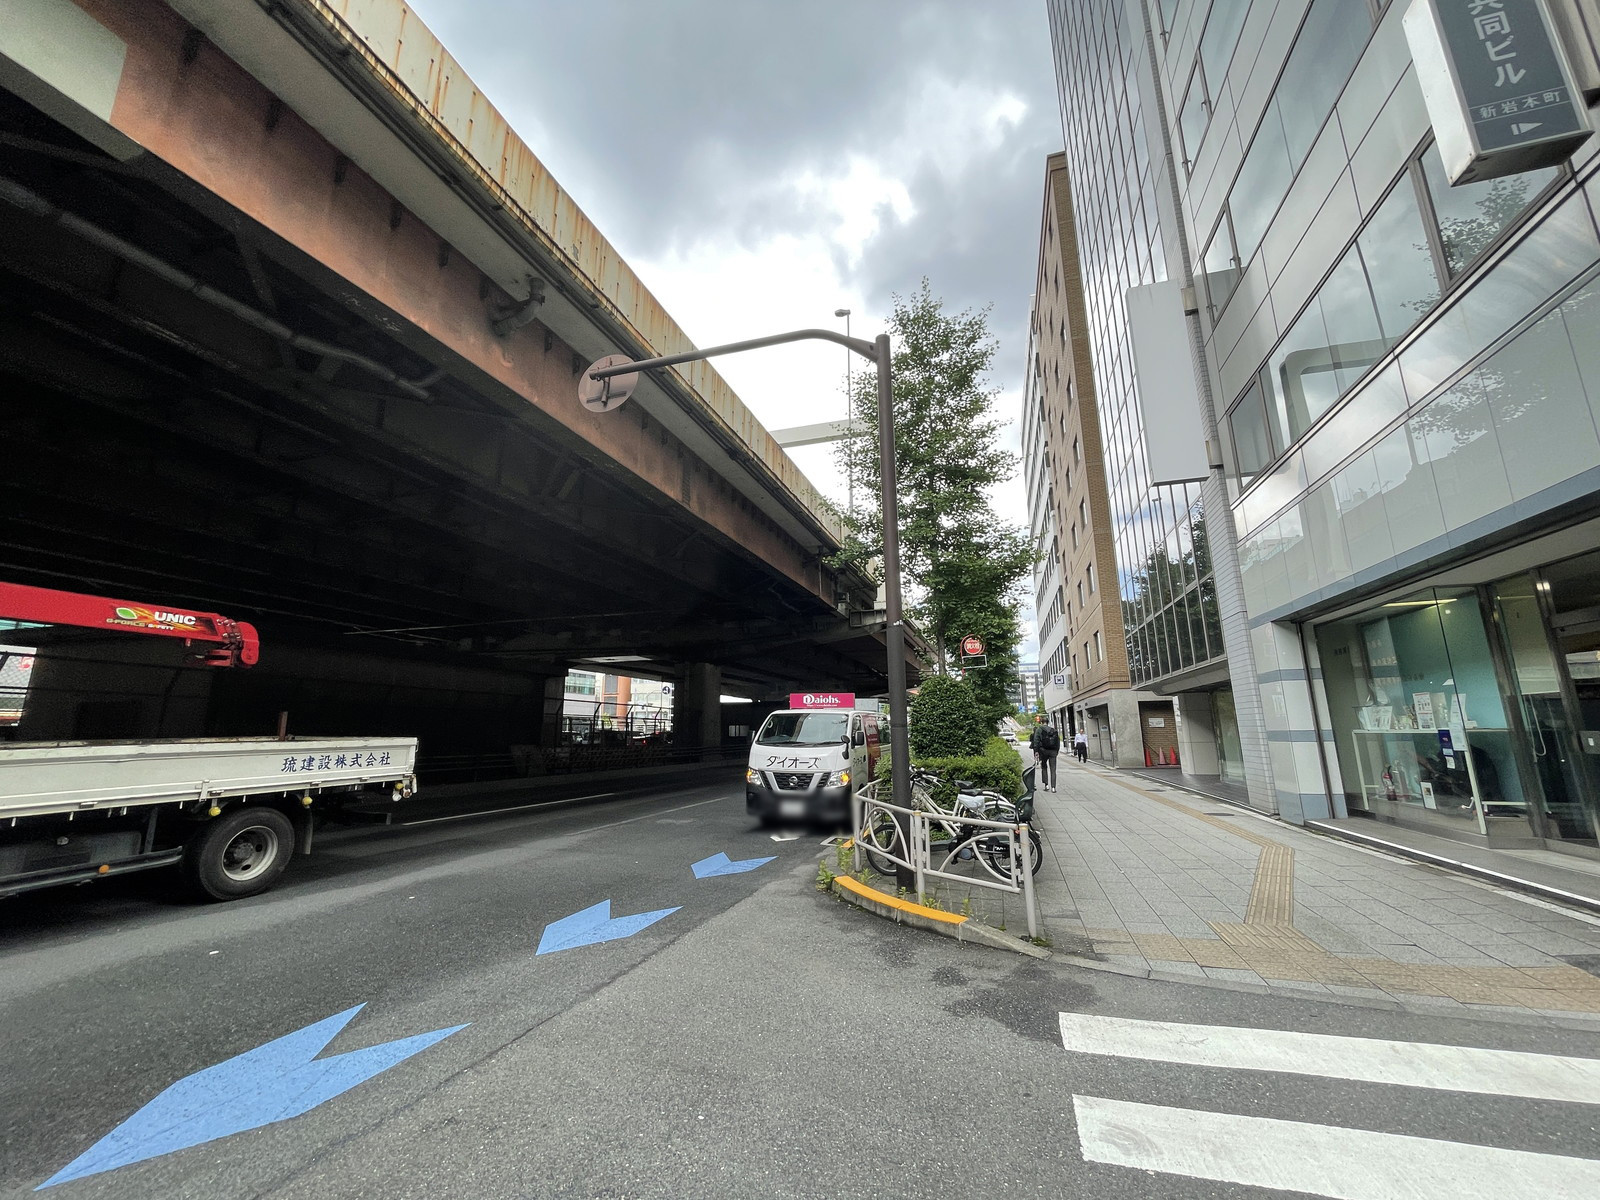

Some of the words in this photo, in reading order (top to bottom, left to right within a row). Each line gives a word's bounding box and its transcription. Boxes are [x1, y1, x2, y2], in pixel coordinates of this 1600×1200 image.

[1480, 91, 1560, 119] 新岩本町
[154, 611, 197, 625] UNIC
[281, 751, 391, 773] 琉建設株式会社
[766, 755, 822, 769] ダイオーズ
